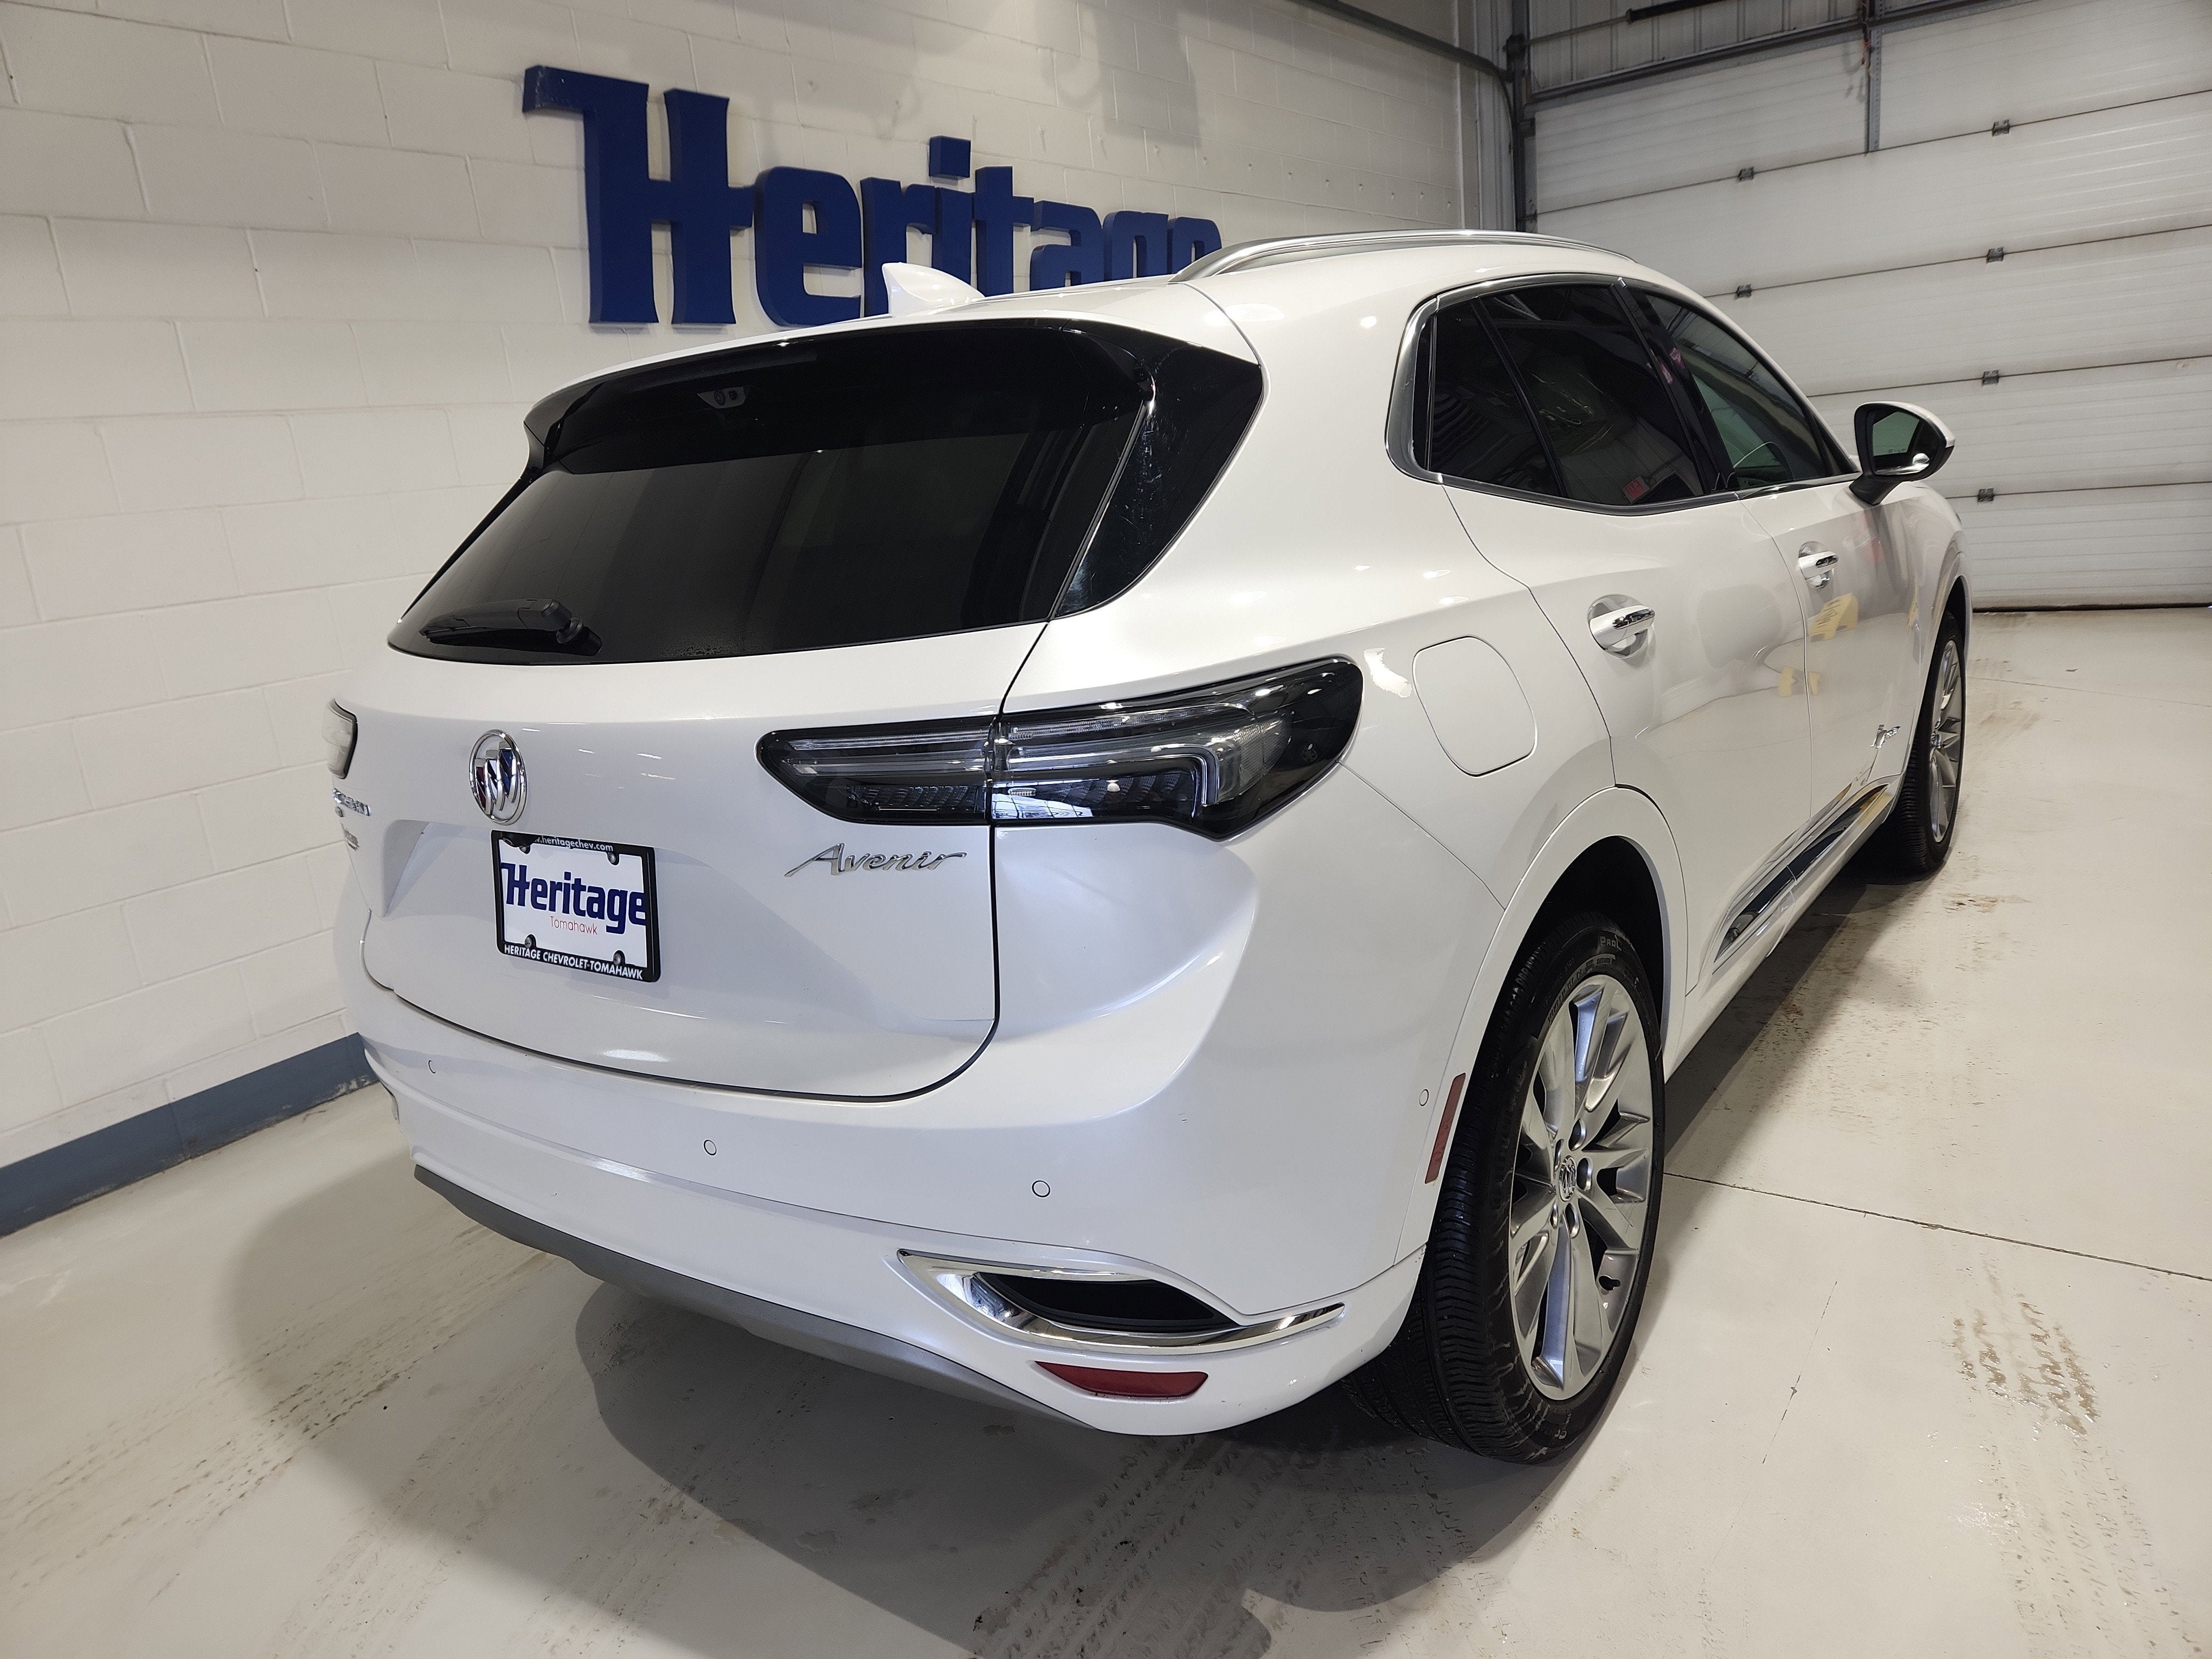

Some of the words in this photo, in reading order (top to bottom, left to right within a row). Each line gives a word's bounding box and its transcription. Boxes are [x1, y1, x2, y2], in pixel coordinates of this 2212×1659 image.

[784, 843, 967, 877] Avenir
[501, 862, 646, 934] Heritage
[550, 916, 597, 935] Tomahawk
[504, 944, 541, 960] HERITAGE
